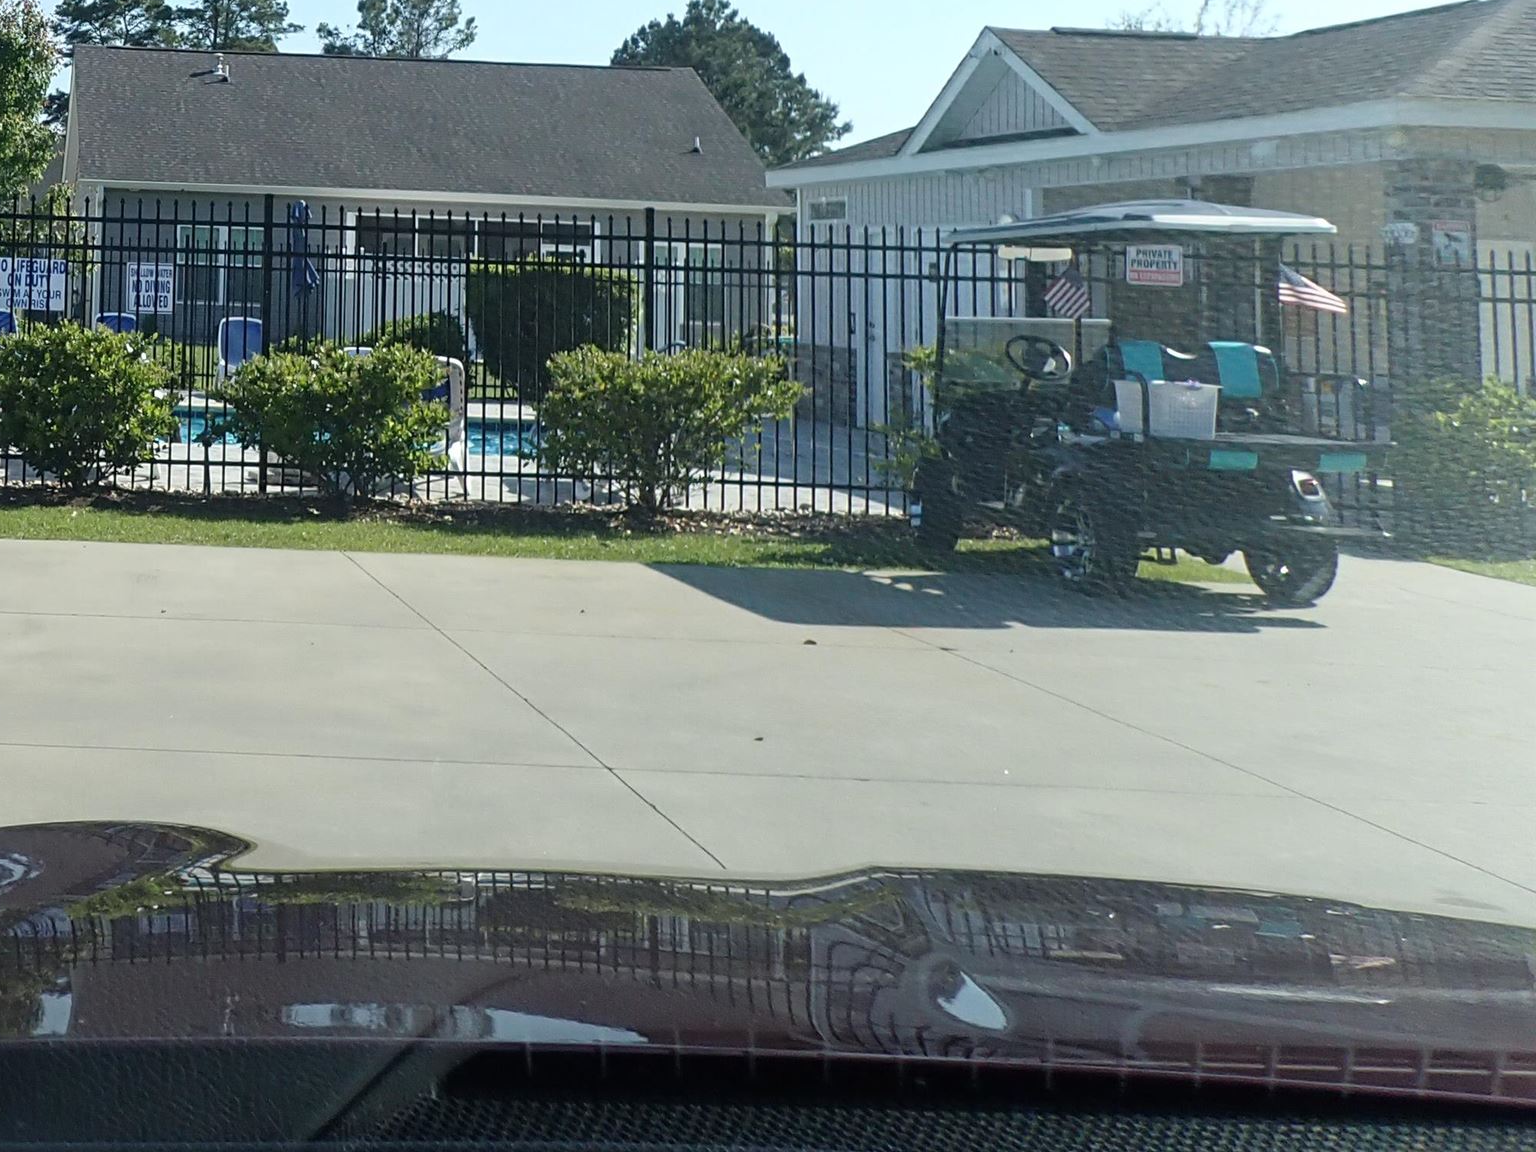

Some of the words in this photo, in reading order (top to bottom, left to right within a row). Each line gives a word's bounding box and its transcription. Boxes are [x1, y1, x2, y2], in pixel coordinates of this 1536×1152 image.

[1136, 249, 1173, 259] PRIVATE
[12, 259, 66, 274] IFEGURD
[1131, 259, 1177, 270] PROPERTY
[130, 268, 155, 278] SHLLOW
[156, 269, 173, 279] ATER
[132, 279, 143, 292] NO
[145, 280, 171, 294] DIVNG
[23, 289, 35, 298] A
[37, 289, 62, 300] YOUR
[31, 299, 49, 309] RIS
[134, 294, 169, 308] ALOED
